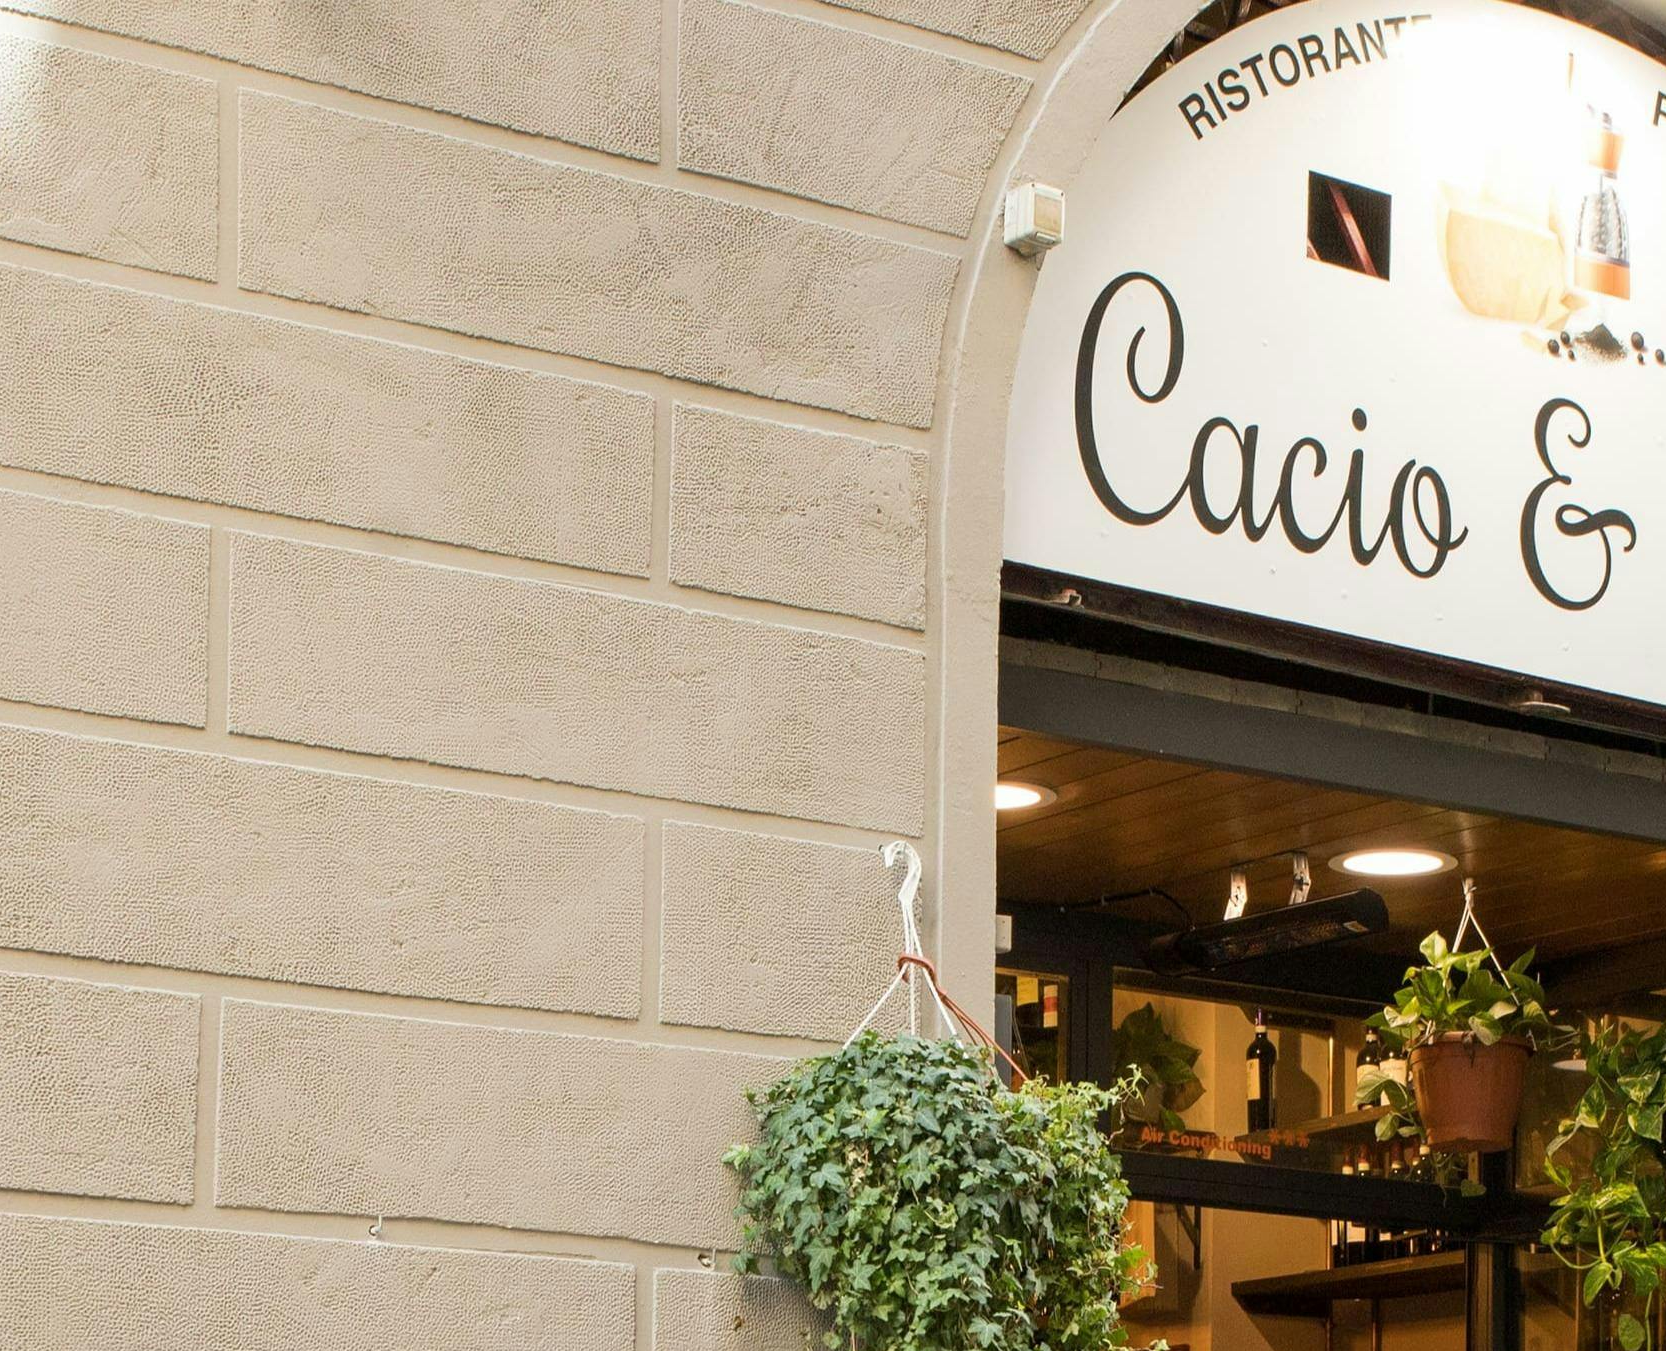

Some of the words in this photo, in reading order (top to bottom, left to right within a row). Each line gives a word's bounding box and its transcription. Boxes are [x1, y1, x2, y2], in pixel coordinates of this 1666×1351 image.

[1178, 14, 1432, 140] RISTORANT
[1075, 271, 1468, 578] Cacio
[1520, 397, 1637, 611] &
[1140, 1126, 1165, 1144] Air
[1169, 1130, 1272, 1160] Conditioning
